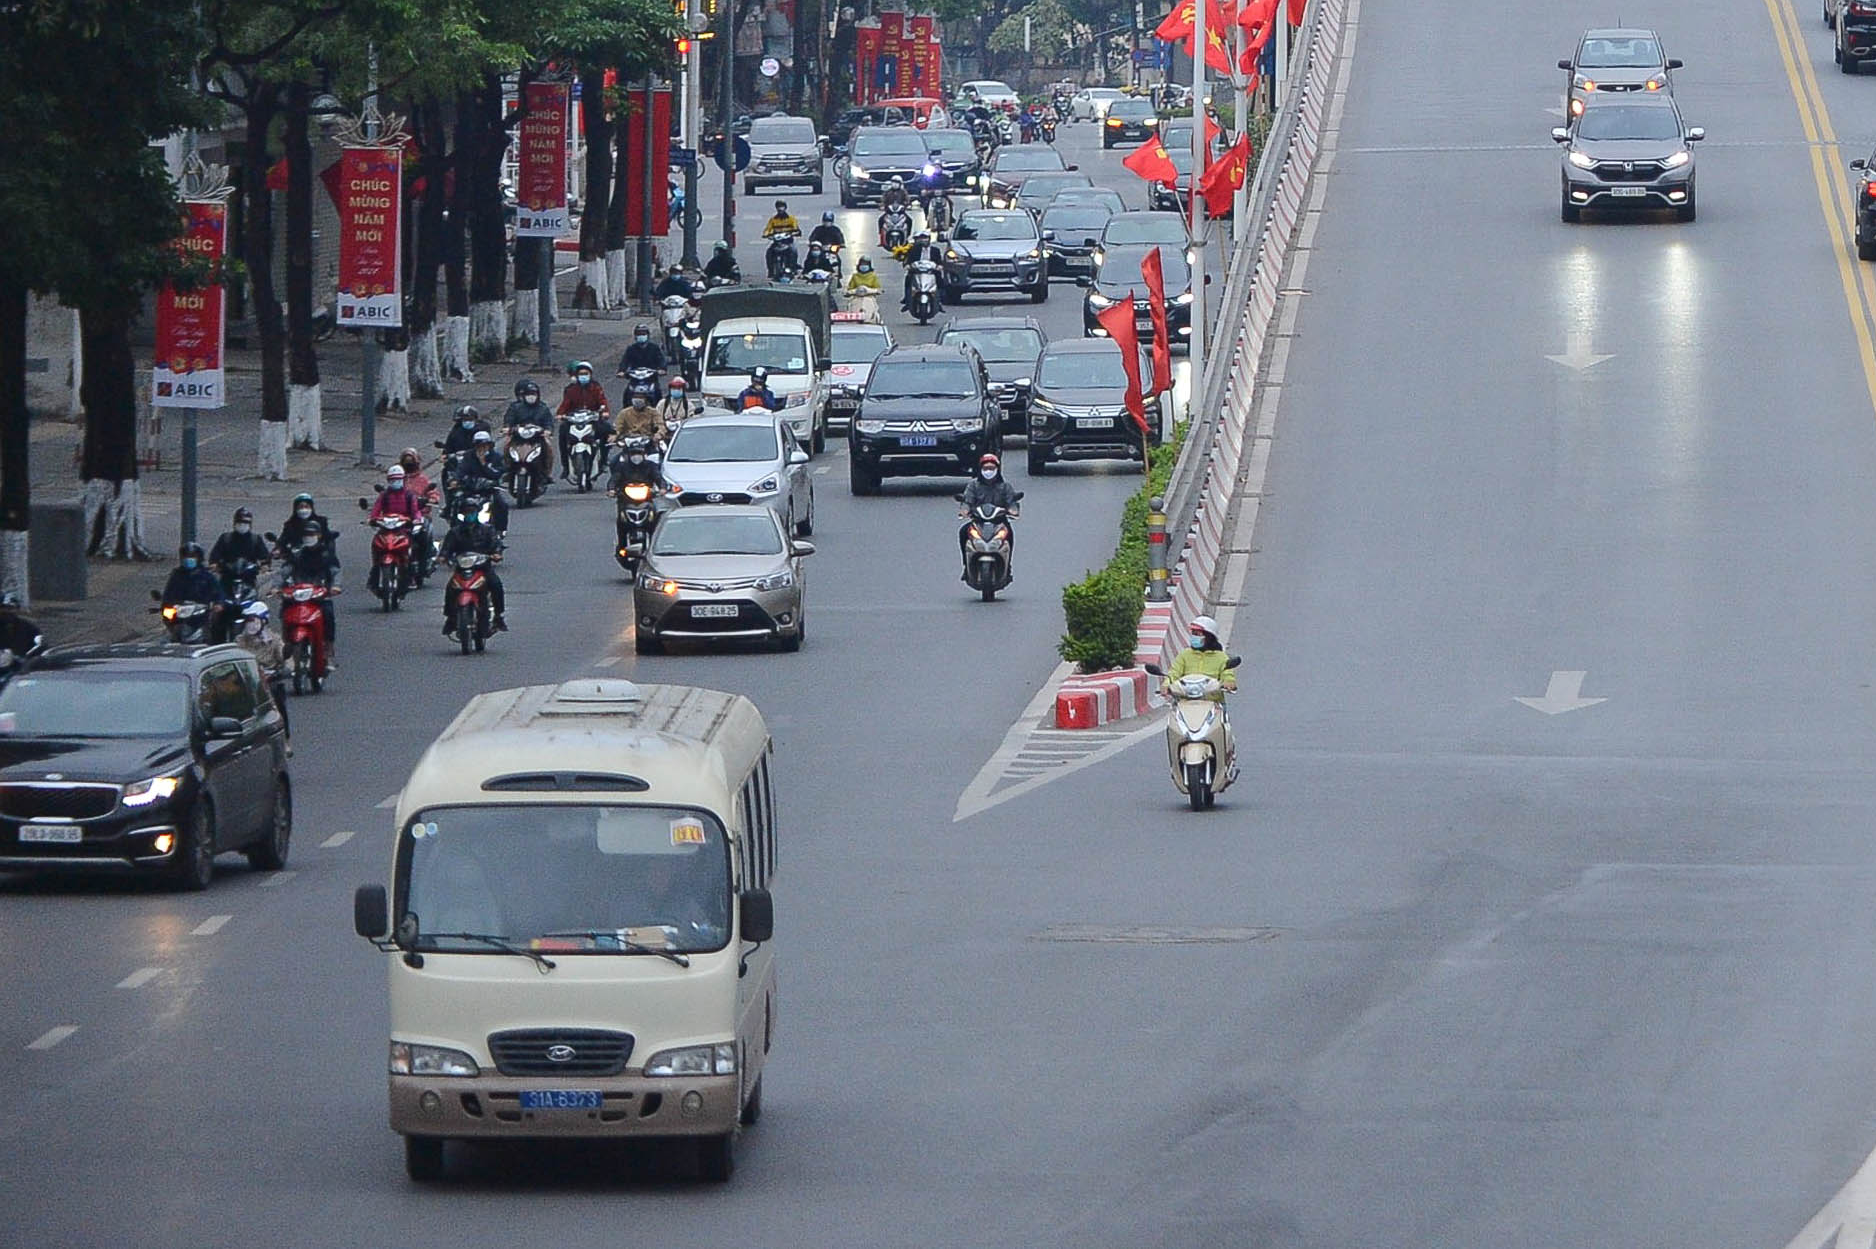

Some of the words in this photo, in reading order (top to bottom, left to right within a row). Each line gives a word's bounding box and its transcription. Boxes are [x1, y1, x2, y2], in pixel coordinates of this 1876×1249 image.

[351, 178, 390, 191] CHÚC
[350, 194, 390, 208] MỪNG
[354, 212, 384, 224] NĂM
[533, 218, 561, 227] ABIC
[356, 229, 381, 242] MỚI
[174, 294, 204, 309] MỚI
[357, 306, 390, 317] ABIC
[175, 383, 214, 396] ABIC
